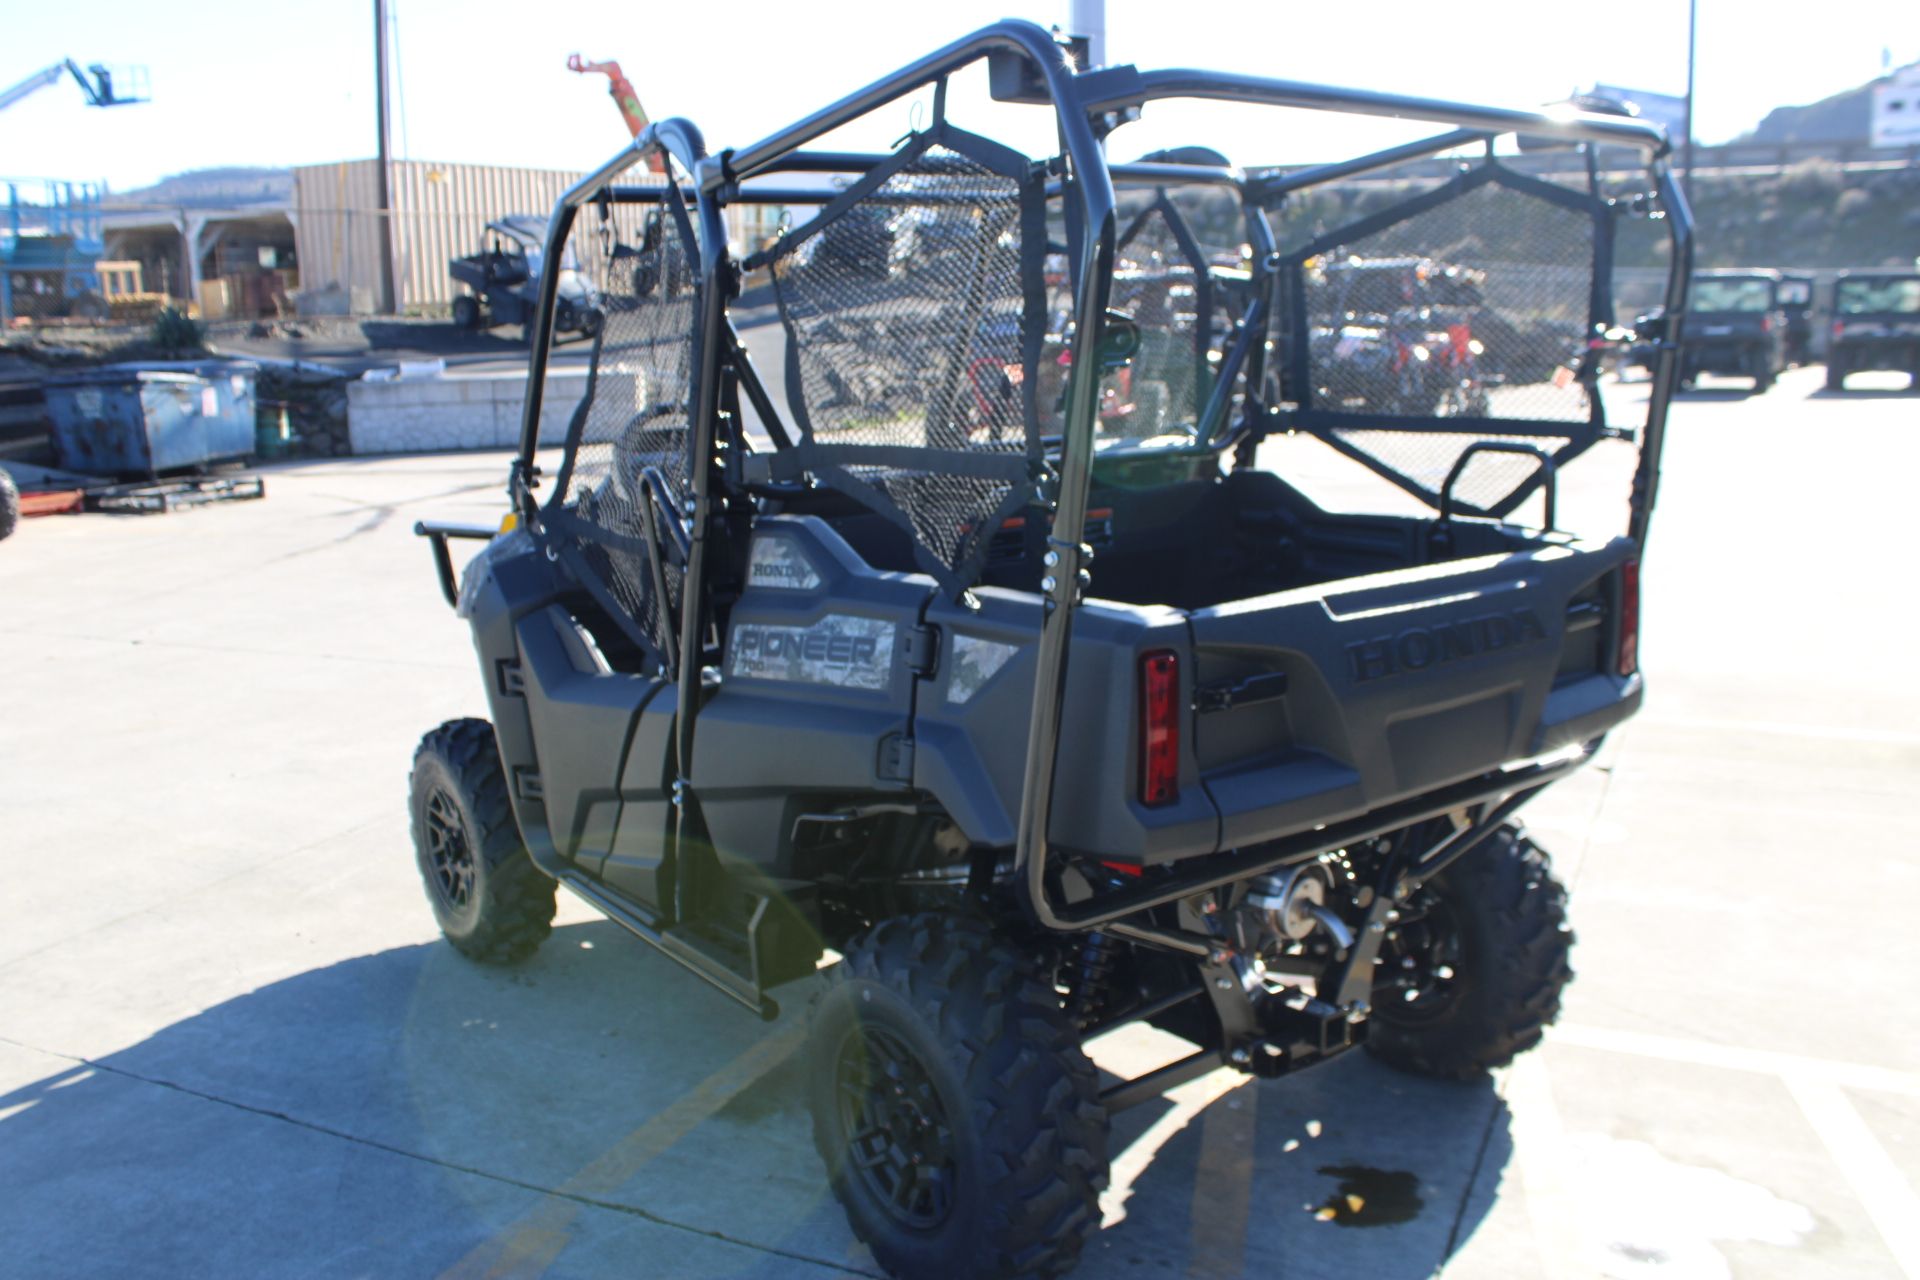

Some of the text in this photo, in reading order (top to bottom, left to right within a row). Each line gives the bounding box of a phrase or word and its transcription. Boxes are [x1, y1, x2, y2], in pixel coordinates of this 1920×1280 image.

[753, 563, 808, 579] HONDA
[740, 631, 876, 664] PIONEER
[1344, 608, 1547, 681] HONDA
